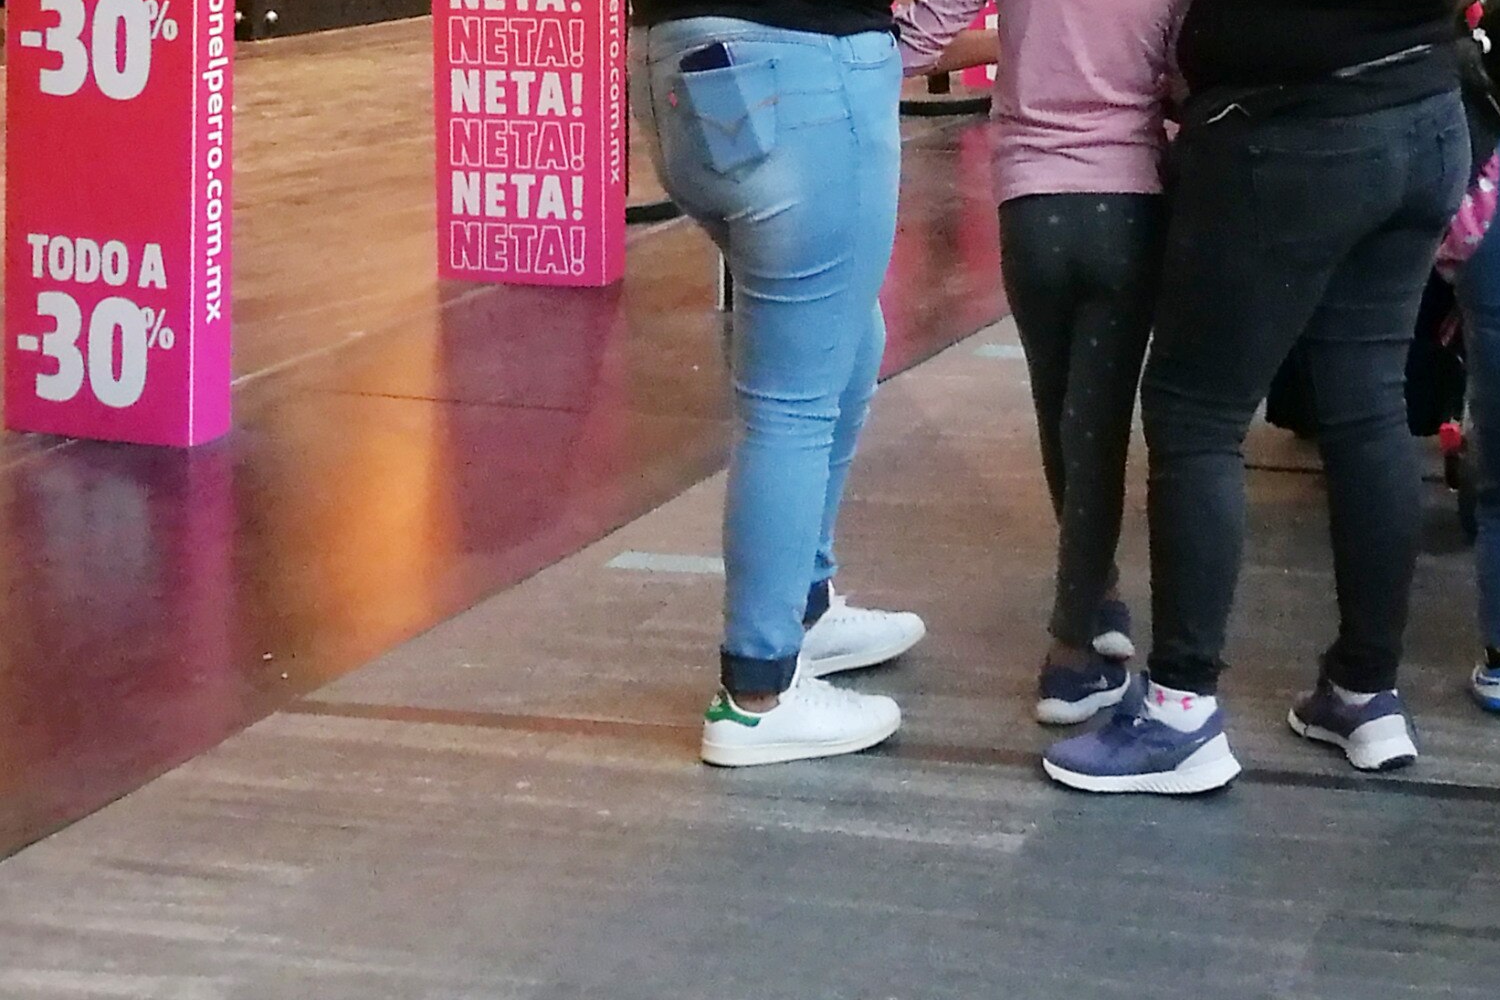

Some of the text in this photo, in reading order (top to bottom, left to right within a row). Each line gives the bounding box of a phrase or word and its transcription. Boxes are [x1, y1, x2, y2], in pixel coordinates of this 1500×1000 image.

[448, 15, 584, 68] NETA!
[450, 68, 583, 117] NETA!
[449, 117, 585, 171] NETA!
[451, 170, 584, 221] NETA!
[27, 233, 167, 289] TODO A
[450, 222, 586, 275] NETA!
[17, 291, 175, 408] -30%
